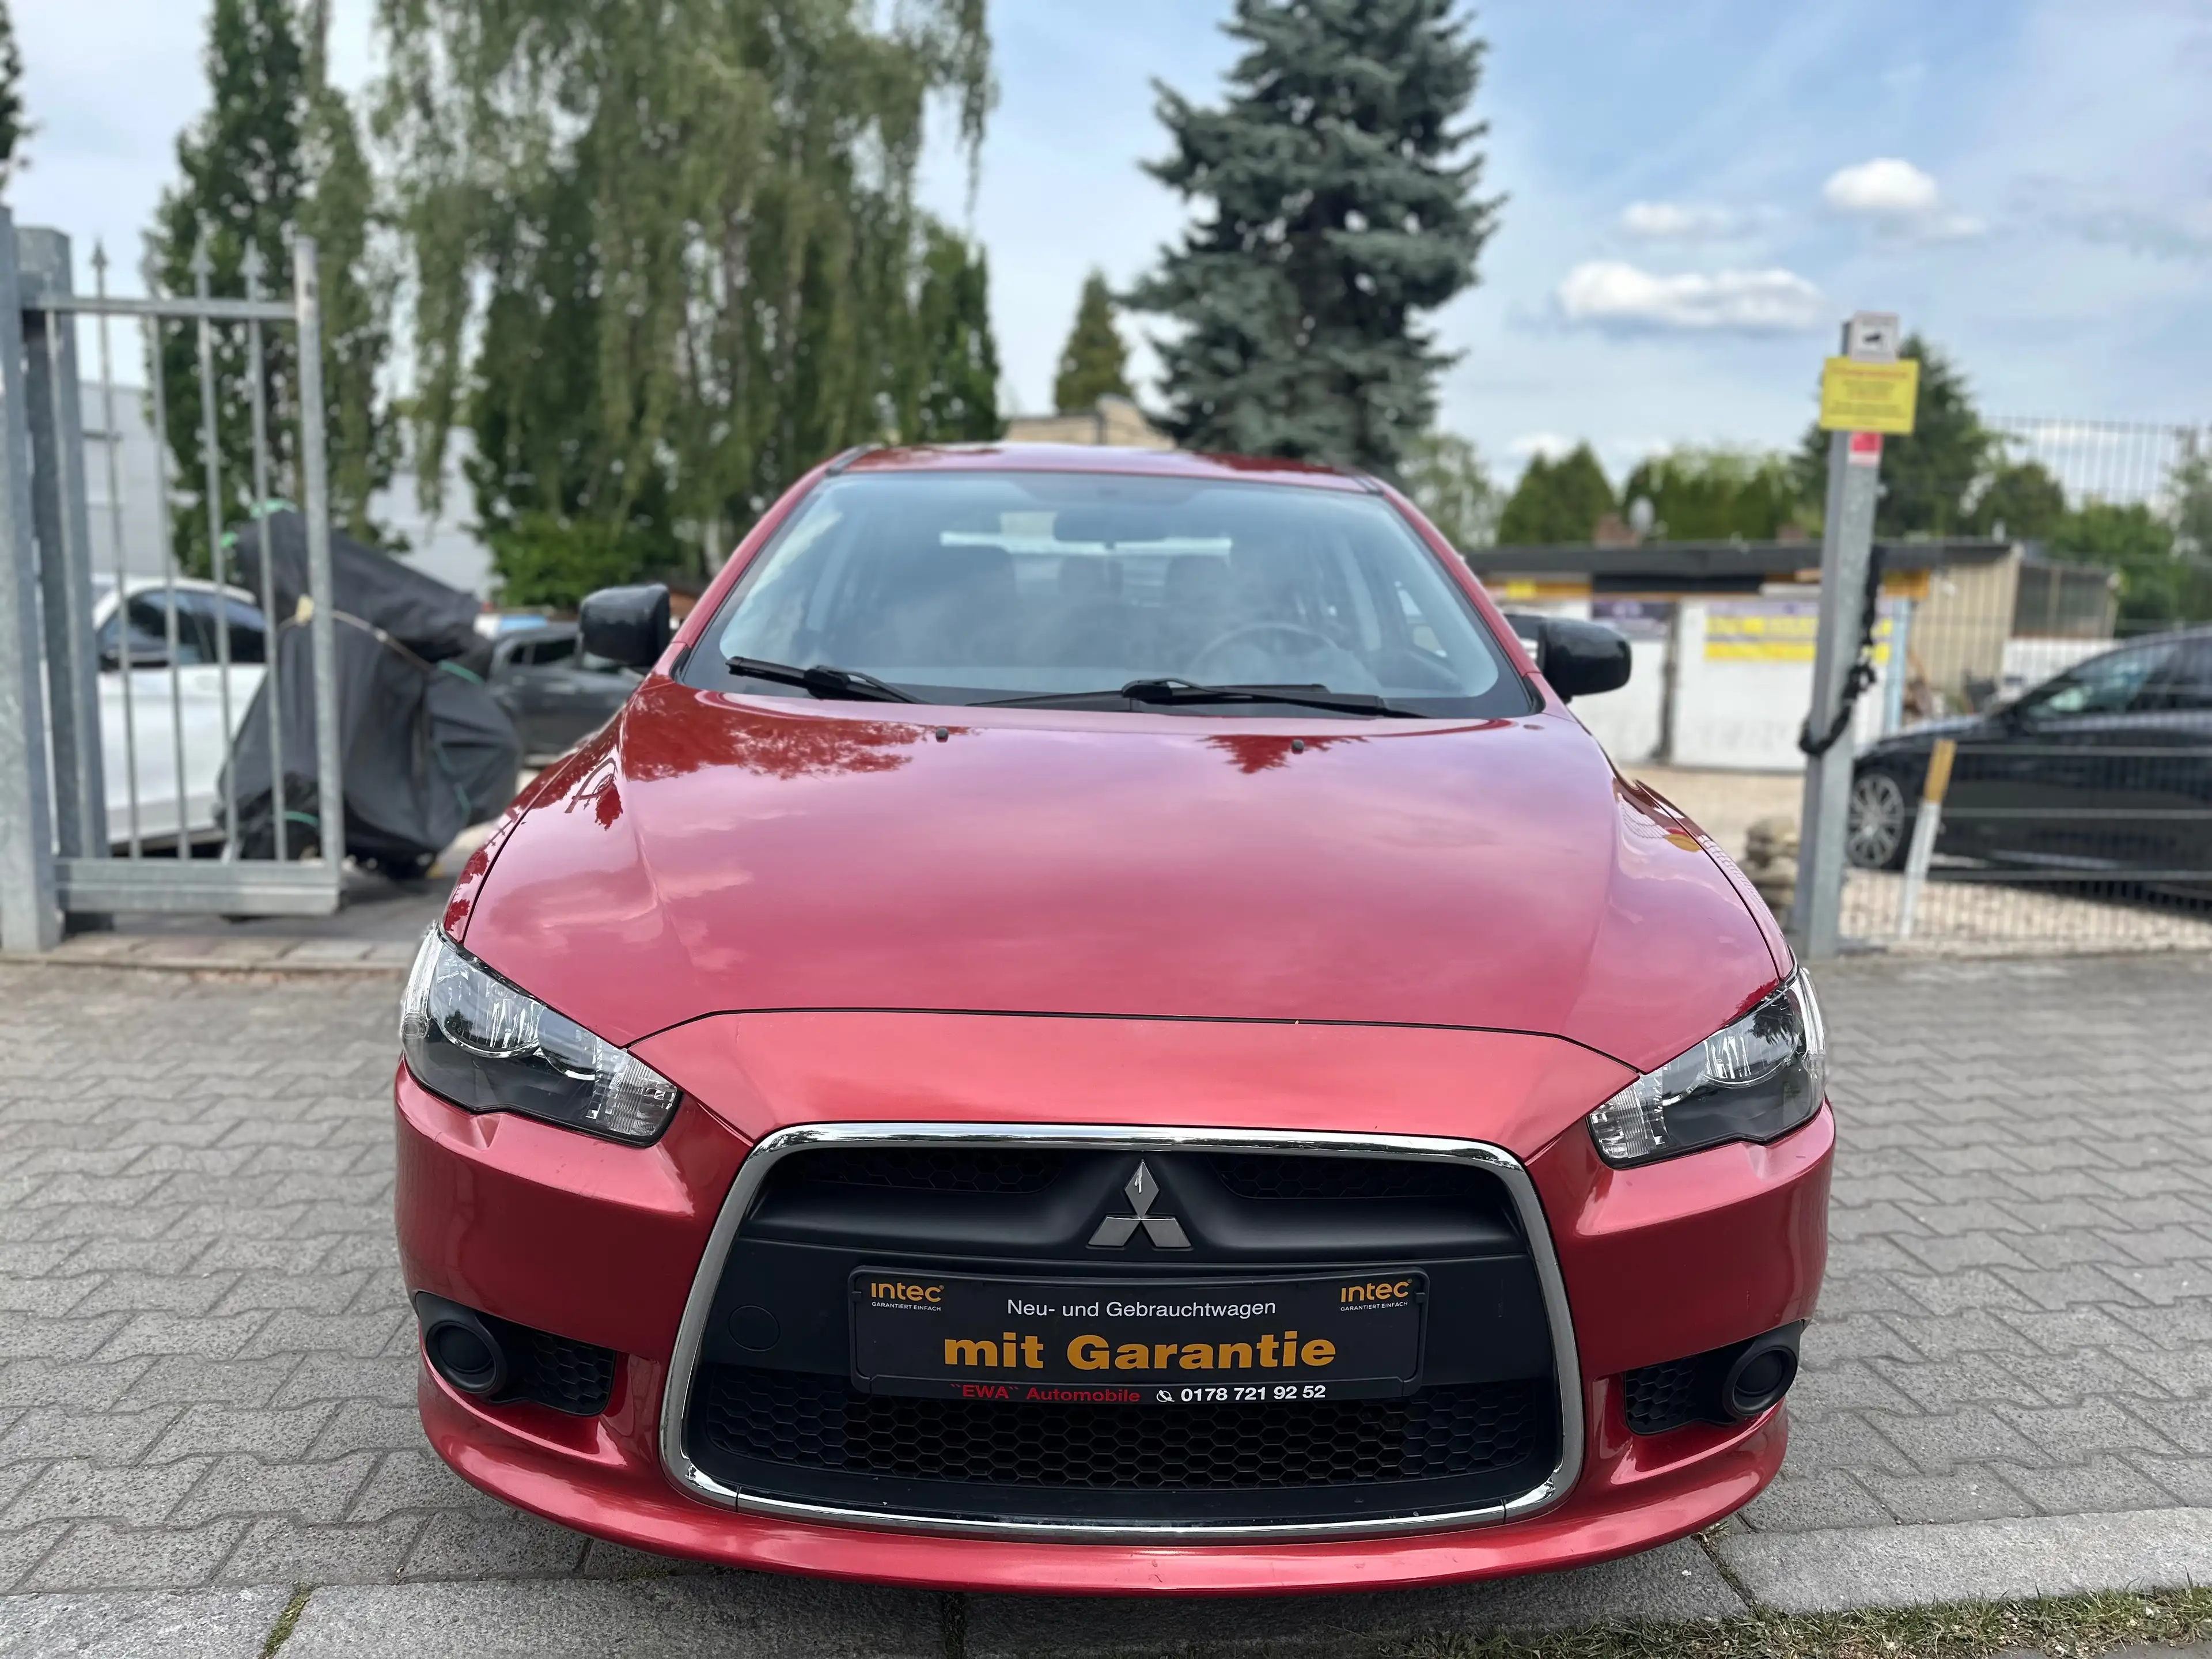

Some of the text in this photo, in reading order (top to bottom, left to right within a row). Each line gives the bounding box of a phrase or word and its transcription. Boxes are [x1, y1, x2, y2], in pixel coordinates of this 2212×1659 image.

[872, 1301, 912, 1310] GARANTIERT
[1007, 1299, 1277, 1319] Neu- und Gebrauchtwagen
[1340, 1304, 1380, 1312] GARANTIERT
[944, 1331, 1336, 1370] mit Garantie
[1026, 1387, 1141, 1402] Automobile
[1181, 1388, 1228, 1402] 0178
[1234, 1387, 1266, 1400] 721
[1274, 1385, 1297, 1400] 92
[1302, 1385, 1326, 1399] 52
